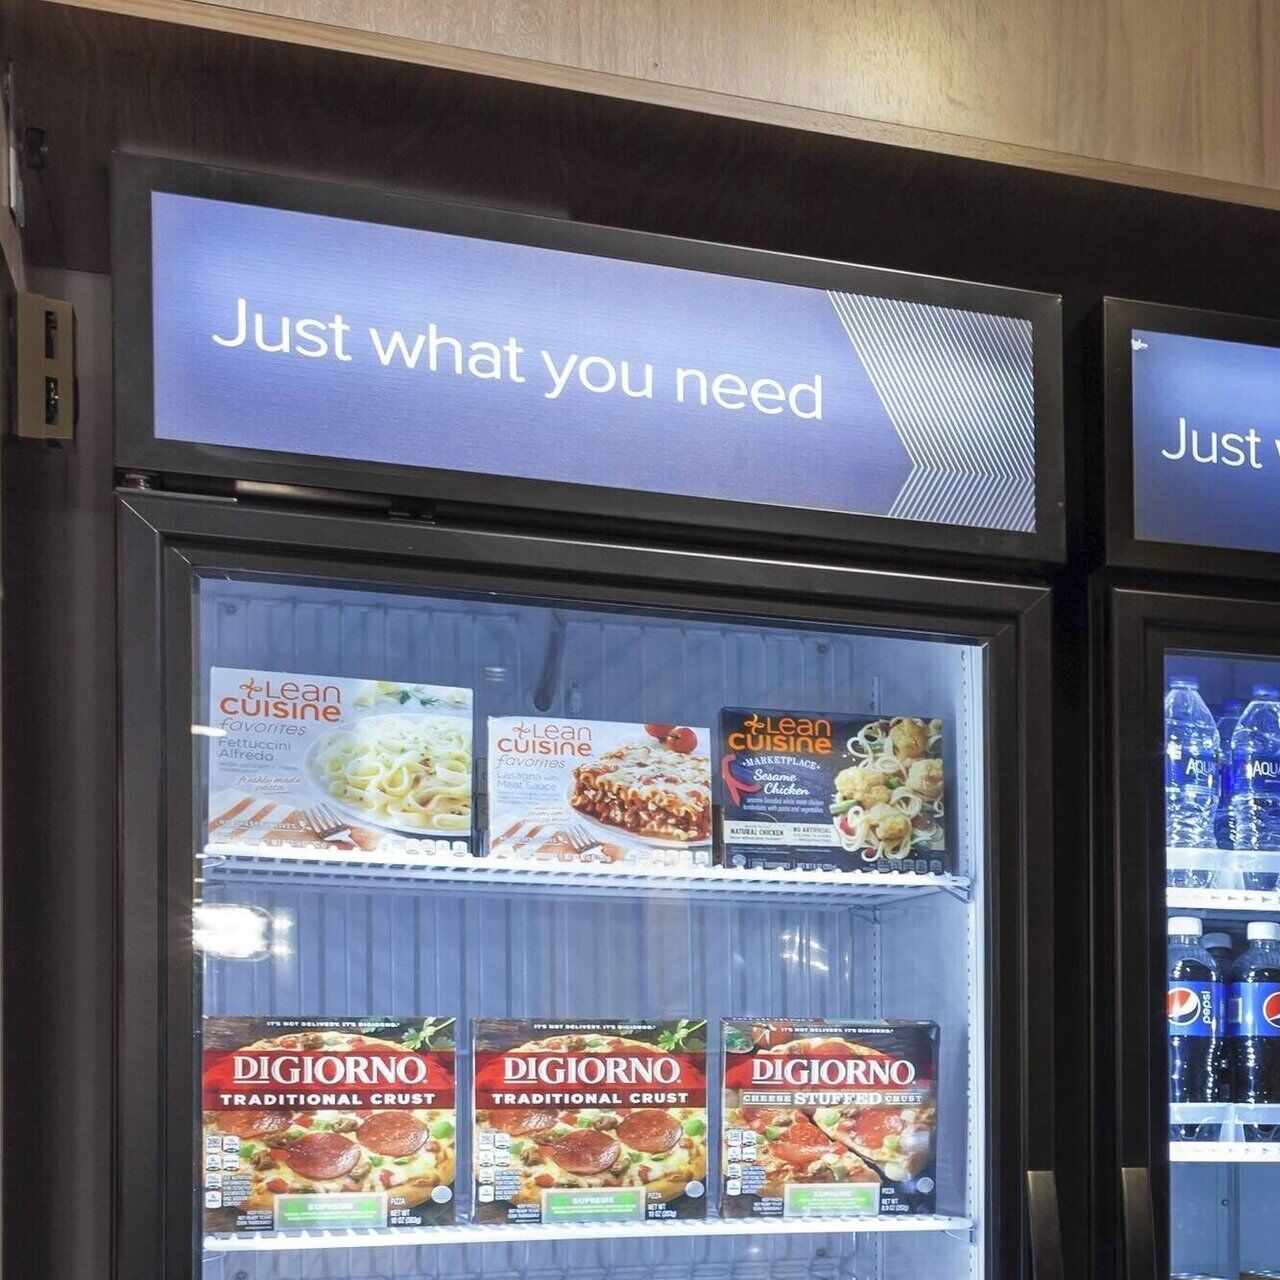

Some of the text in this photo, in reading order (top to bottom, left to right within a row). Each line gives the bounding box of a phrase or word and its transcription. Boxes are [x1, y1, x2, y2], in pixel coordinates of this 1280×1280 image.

[212, 298, 823, 420] Just what you need
[1162, 418, 1262, 470] Just
[266, 681, 341, 703] Lean
[219, 718, 306, 736] favorites
[532, 723, 592, 741] Lean
[767, 717, 831, 736] Lean
[219, 738, 291, 751] Fettuccini
[219, 749, 274, 761] Alfredo
[494, 754, 565, 769] favorites
[746, 756, 817, 769] MARKETPLACE
[754, 769, 797, 782] Sesame
[497, 780, 525, 790] Meat
[764, 783, 810, 795] Chicken
[1202, 990, 1212, 1025] pepsi
[221, 1093, 435, 1105] TRADITIONAL CRUST
[493, 1093, 688, 1104] TRADITIONAL CRUST
[743, 1092, 922, 1105] CHEESE STUFFED CRUST
